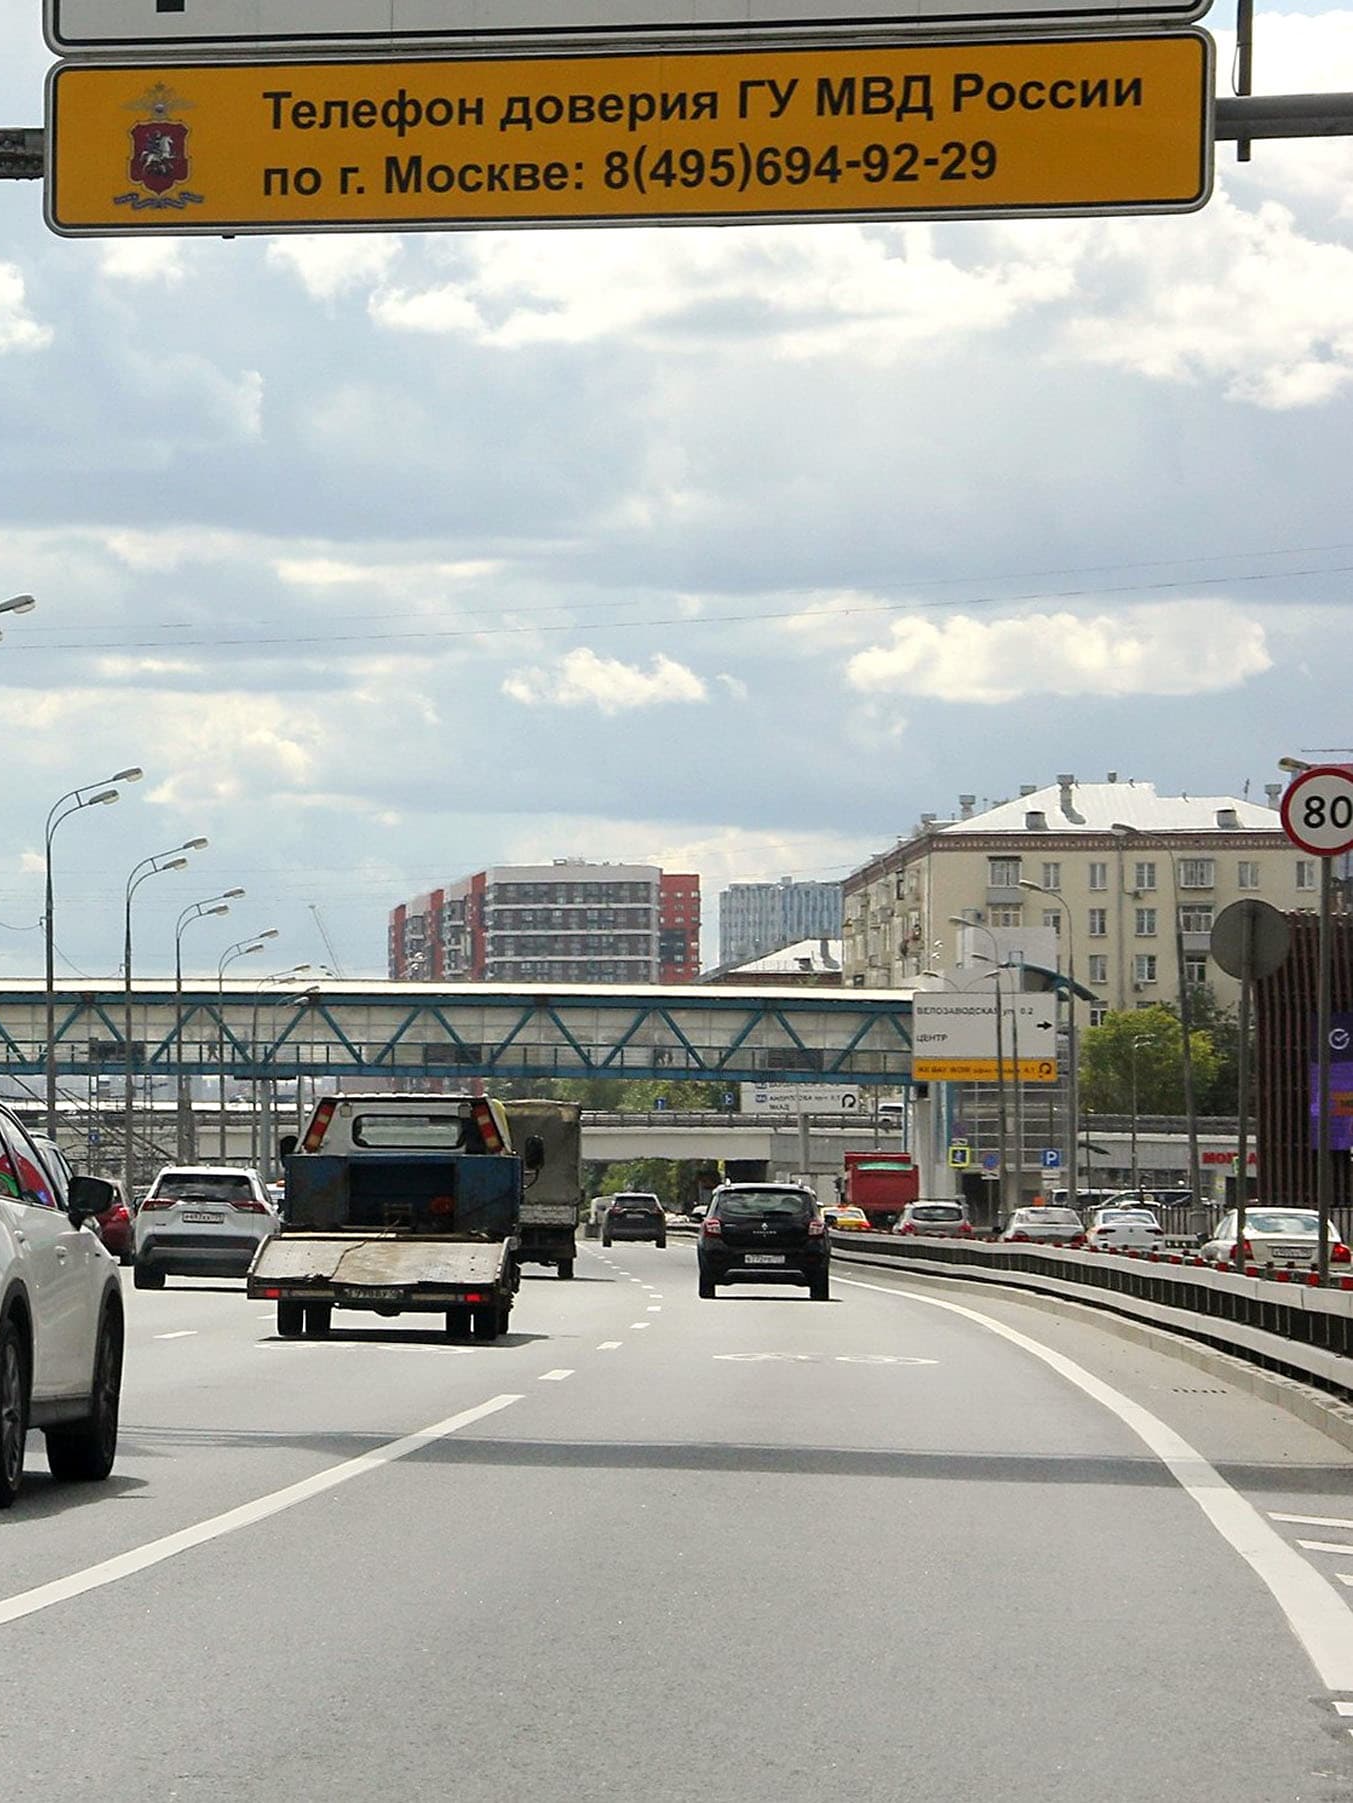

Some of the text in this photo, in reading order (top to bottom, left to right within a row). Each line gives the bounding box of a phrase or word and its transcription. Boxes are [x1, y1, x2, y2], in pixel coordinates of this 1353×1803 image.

[261, 72, 1143, 138] Телефон доверия ГУ МВД России
[263, 139, 998, 197] по г. Москве: 8(495)694-92-29
[1303, 795, 1353, 829] 80
[916, 1034, 948, 1043] ЦЕНТР
